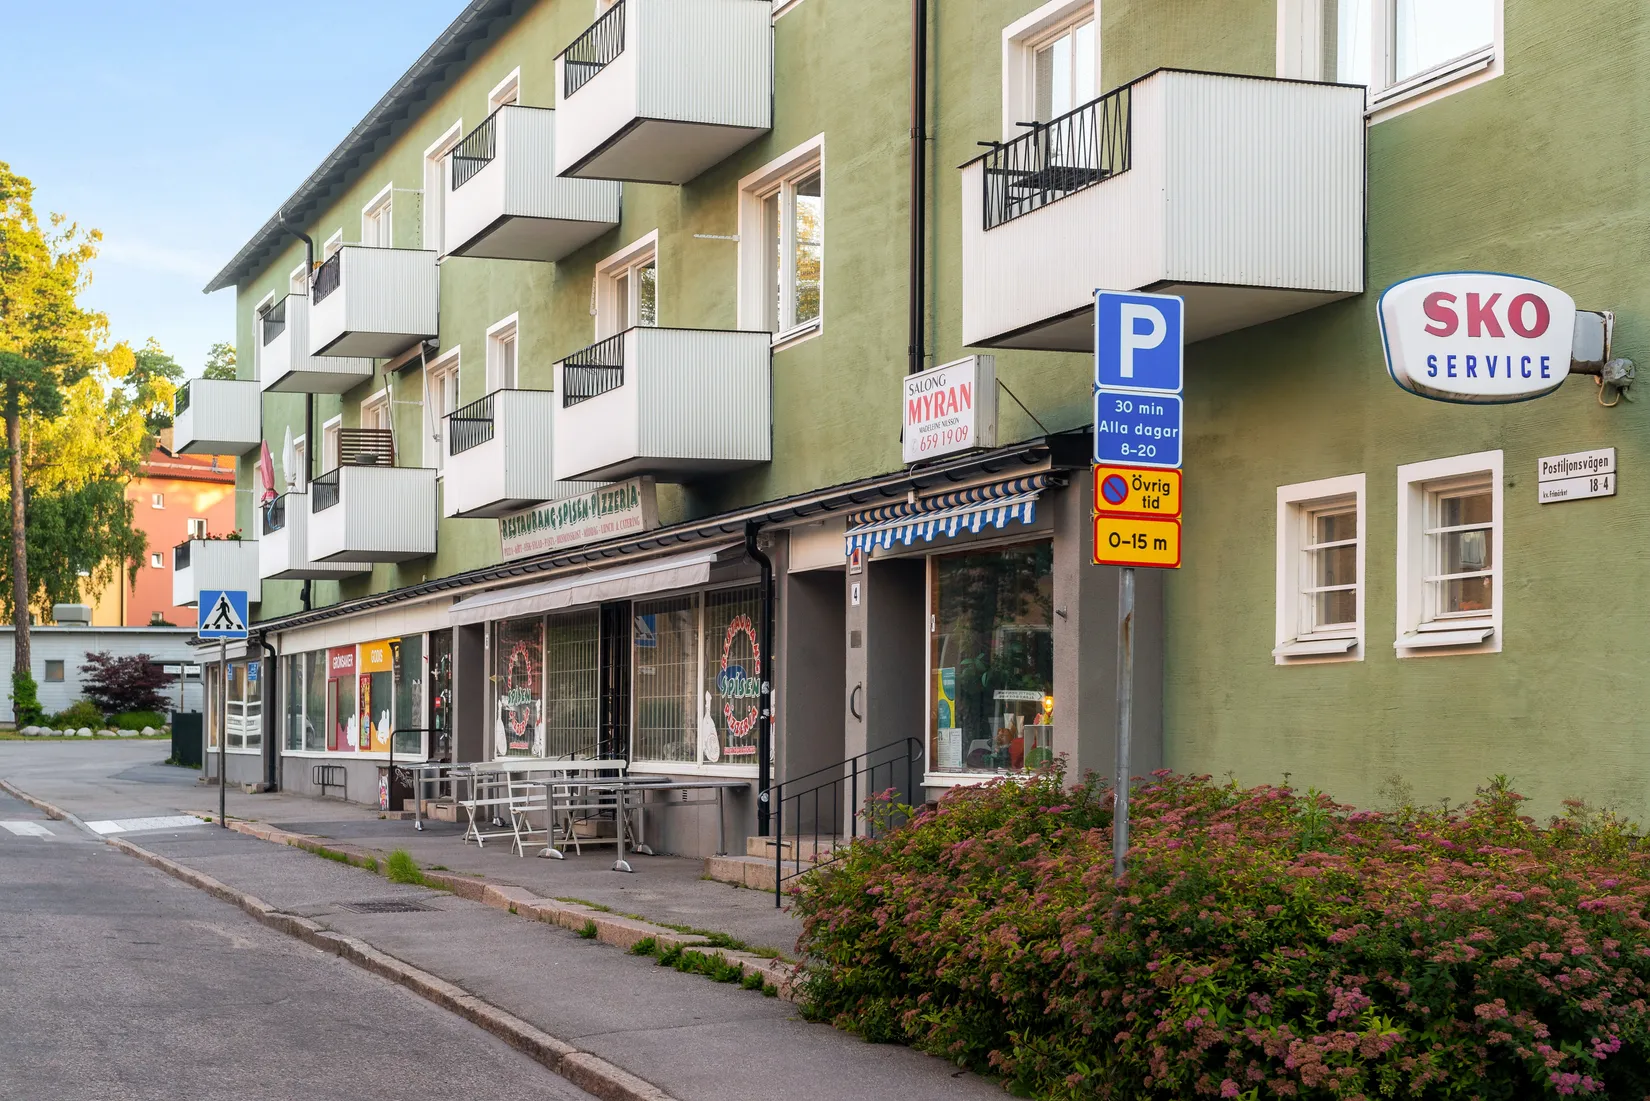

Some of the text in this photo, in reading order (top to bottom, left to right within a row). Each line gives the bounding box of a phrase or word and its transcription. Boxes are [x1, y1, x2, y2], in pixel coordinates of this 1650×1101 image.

[1423, 291, 1550, 339] SKO
[1120, 302, 1167, 378] P
[1427, 354, 1551, 379] SERVICE
[908, 374, 946, 396] SALONG
[908, 381, 971, 426] MYRAN
[1115, 400, 1164, 416] 30 min
[919, 417, 959, 434] MADELEINE NILSSON
[1099, 420, 1178, 439] Alla dagar
[920, 424, 969, 452] 659 19 09
[1121, 443, 1156, 457] 8-20
[1542, 455, 1609, 476] Postiljonsvägen
[1132, 474, 1171, 496] Övrig
[1142, 495, 1160, 509] tid
[1109, 531, 1167, 551] 0-15 m
[853, 587, 858, 601] 4
